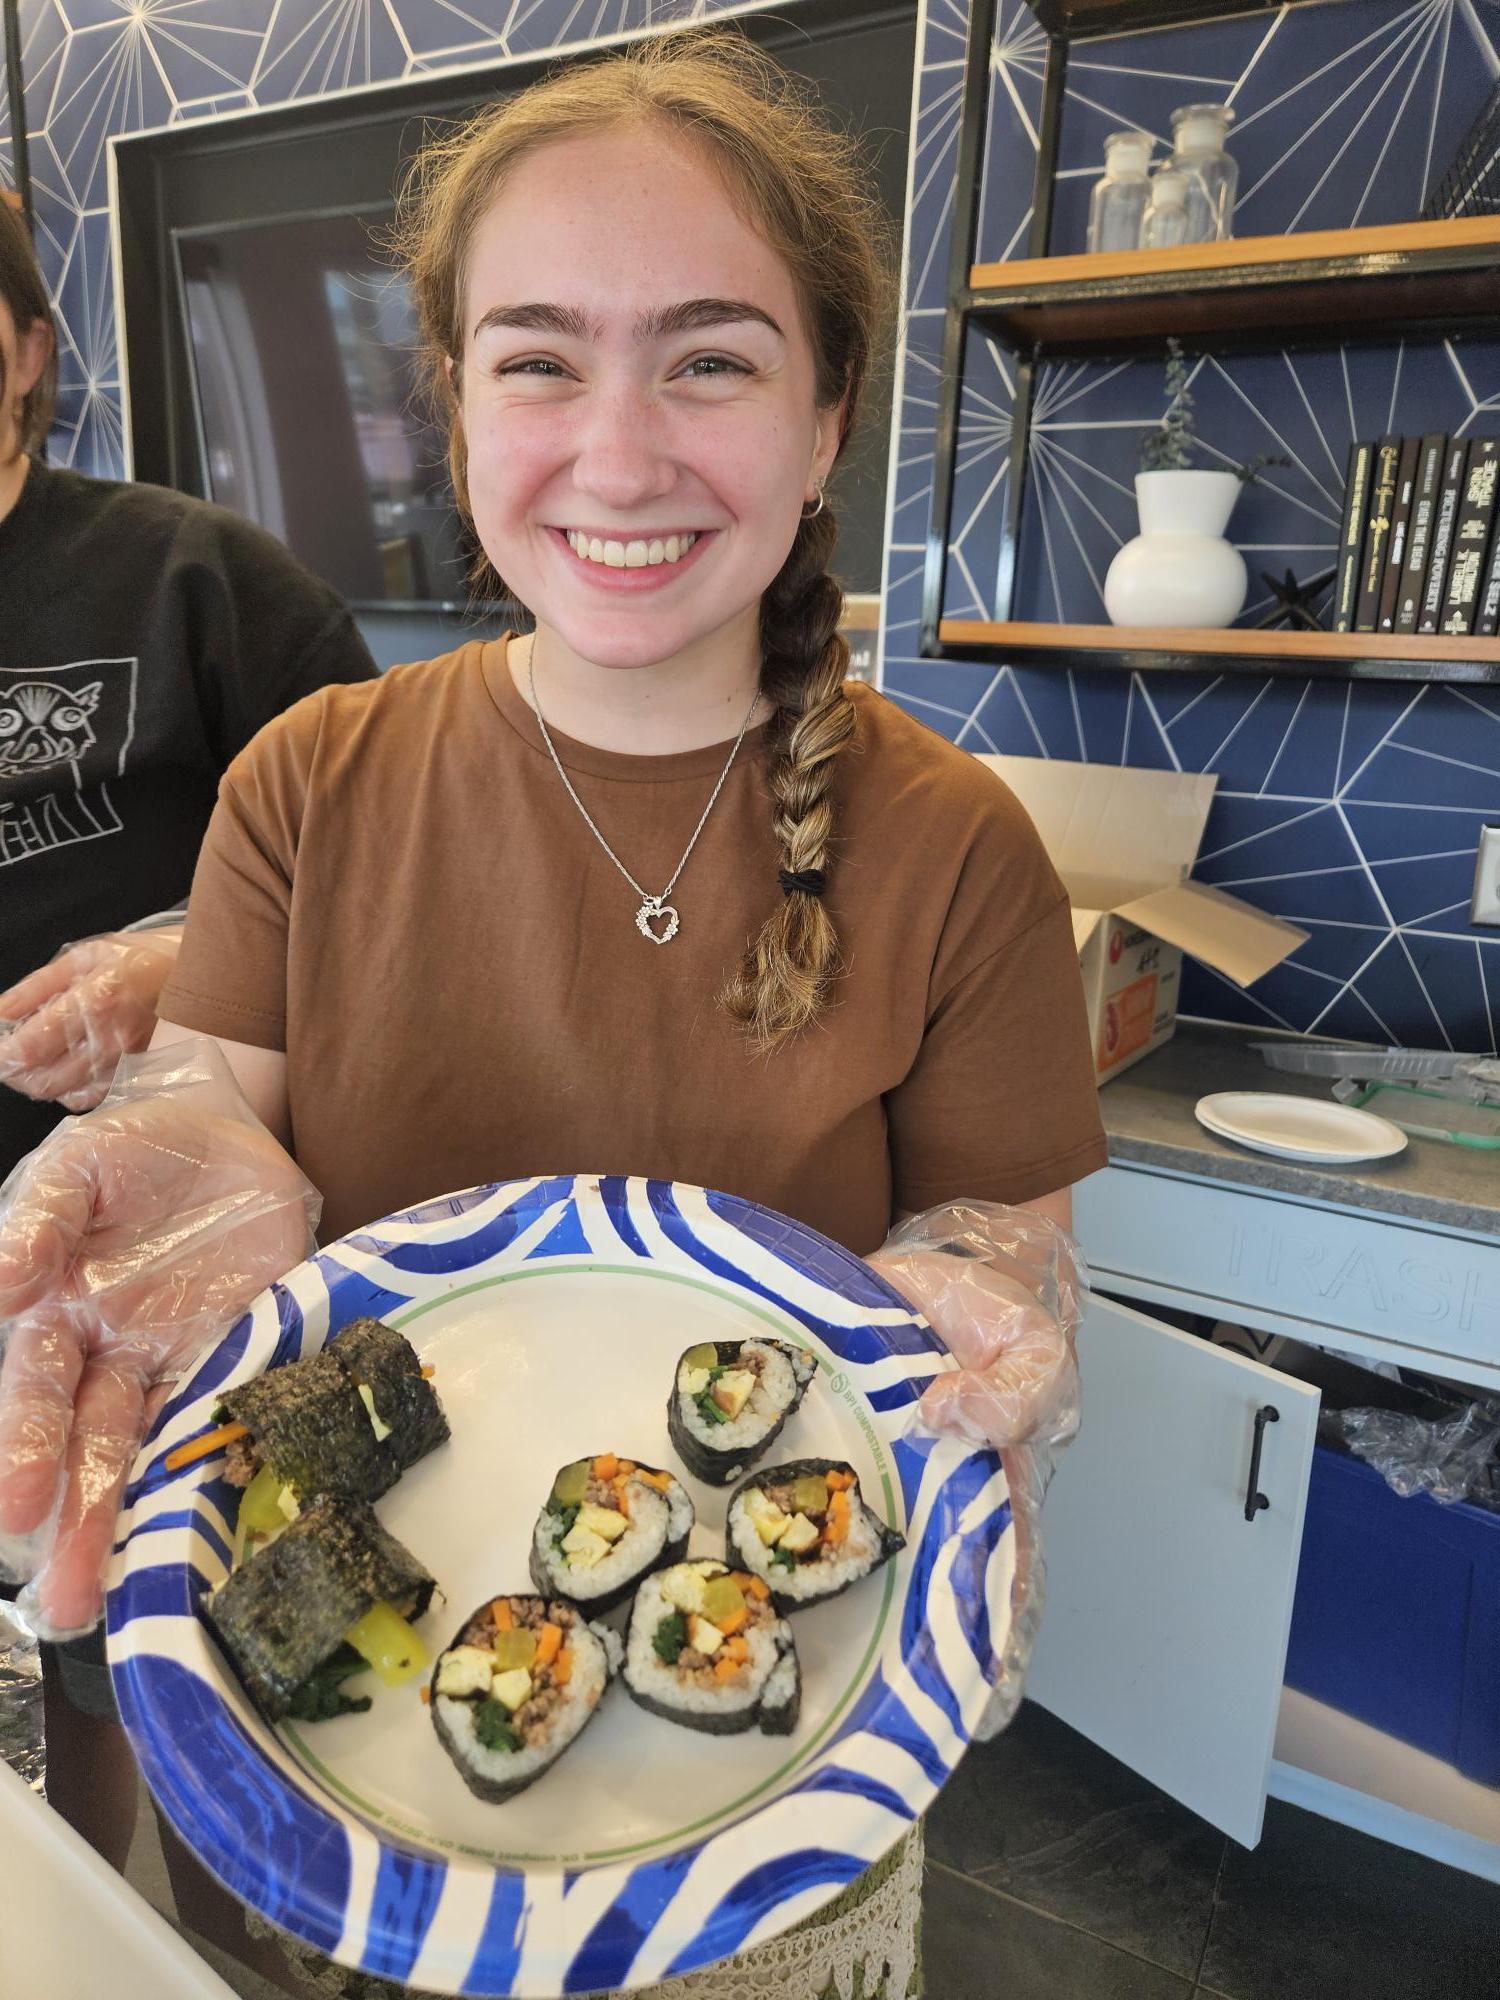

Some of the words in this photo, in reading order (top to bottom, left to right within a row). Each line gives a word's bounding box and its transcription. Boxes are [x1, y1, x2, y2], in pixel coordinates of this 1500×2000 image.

[1467, 466, 1485, 502] SKIN
[1477, 459, 1498, 509] TRADE
[1413, 525, 1427, 545] THE
[1434, 488, 1456, 556] PICTURING
[1409, 545, 1424, 571] DEAD
[1425, 556, 1445, 613] POVERTY
[854, 1406, 886, 1471] COMPOSTABLE
